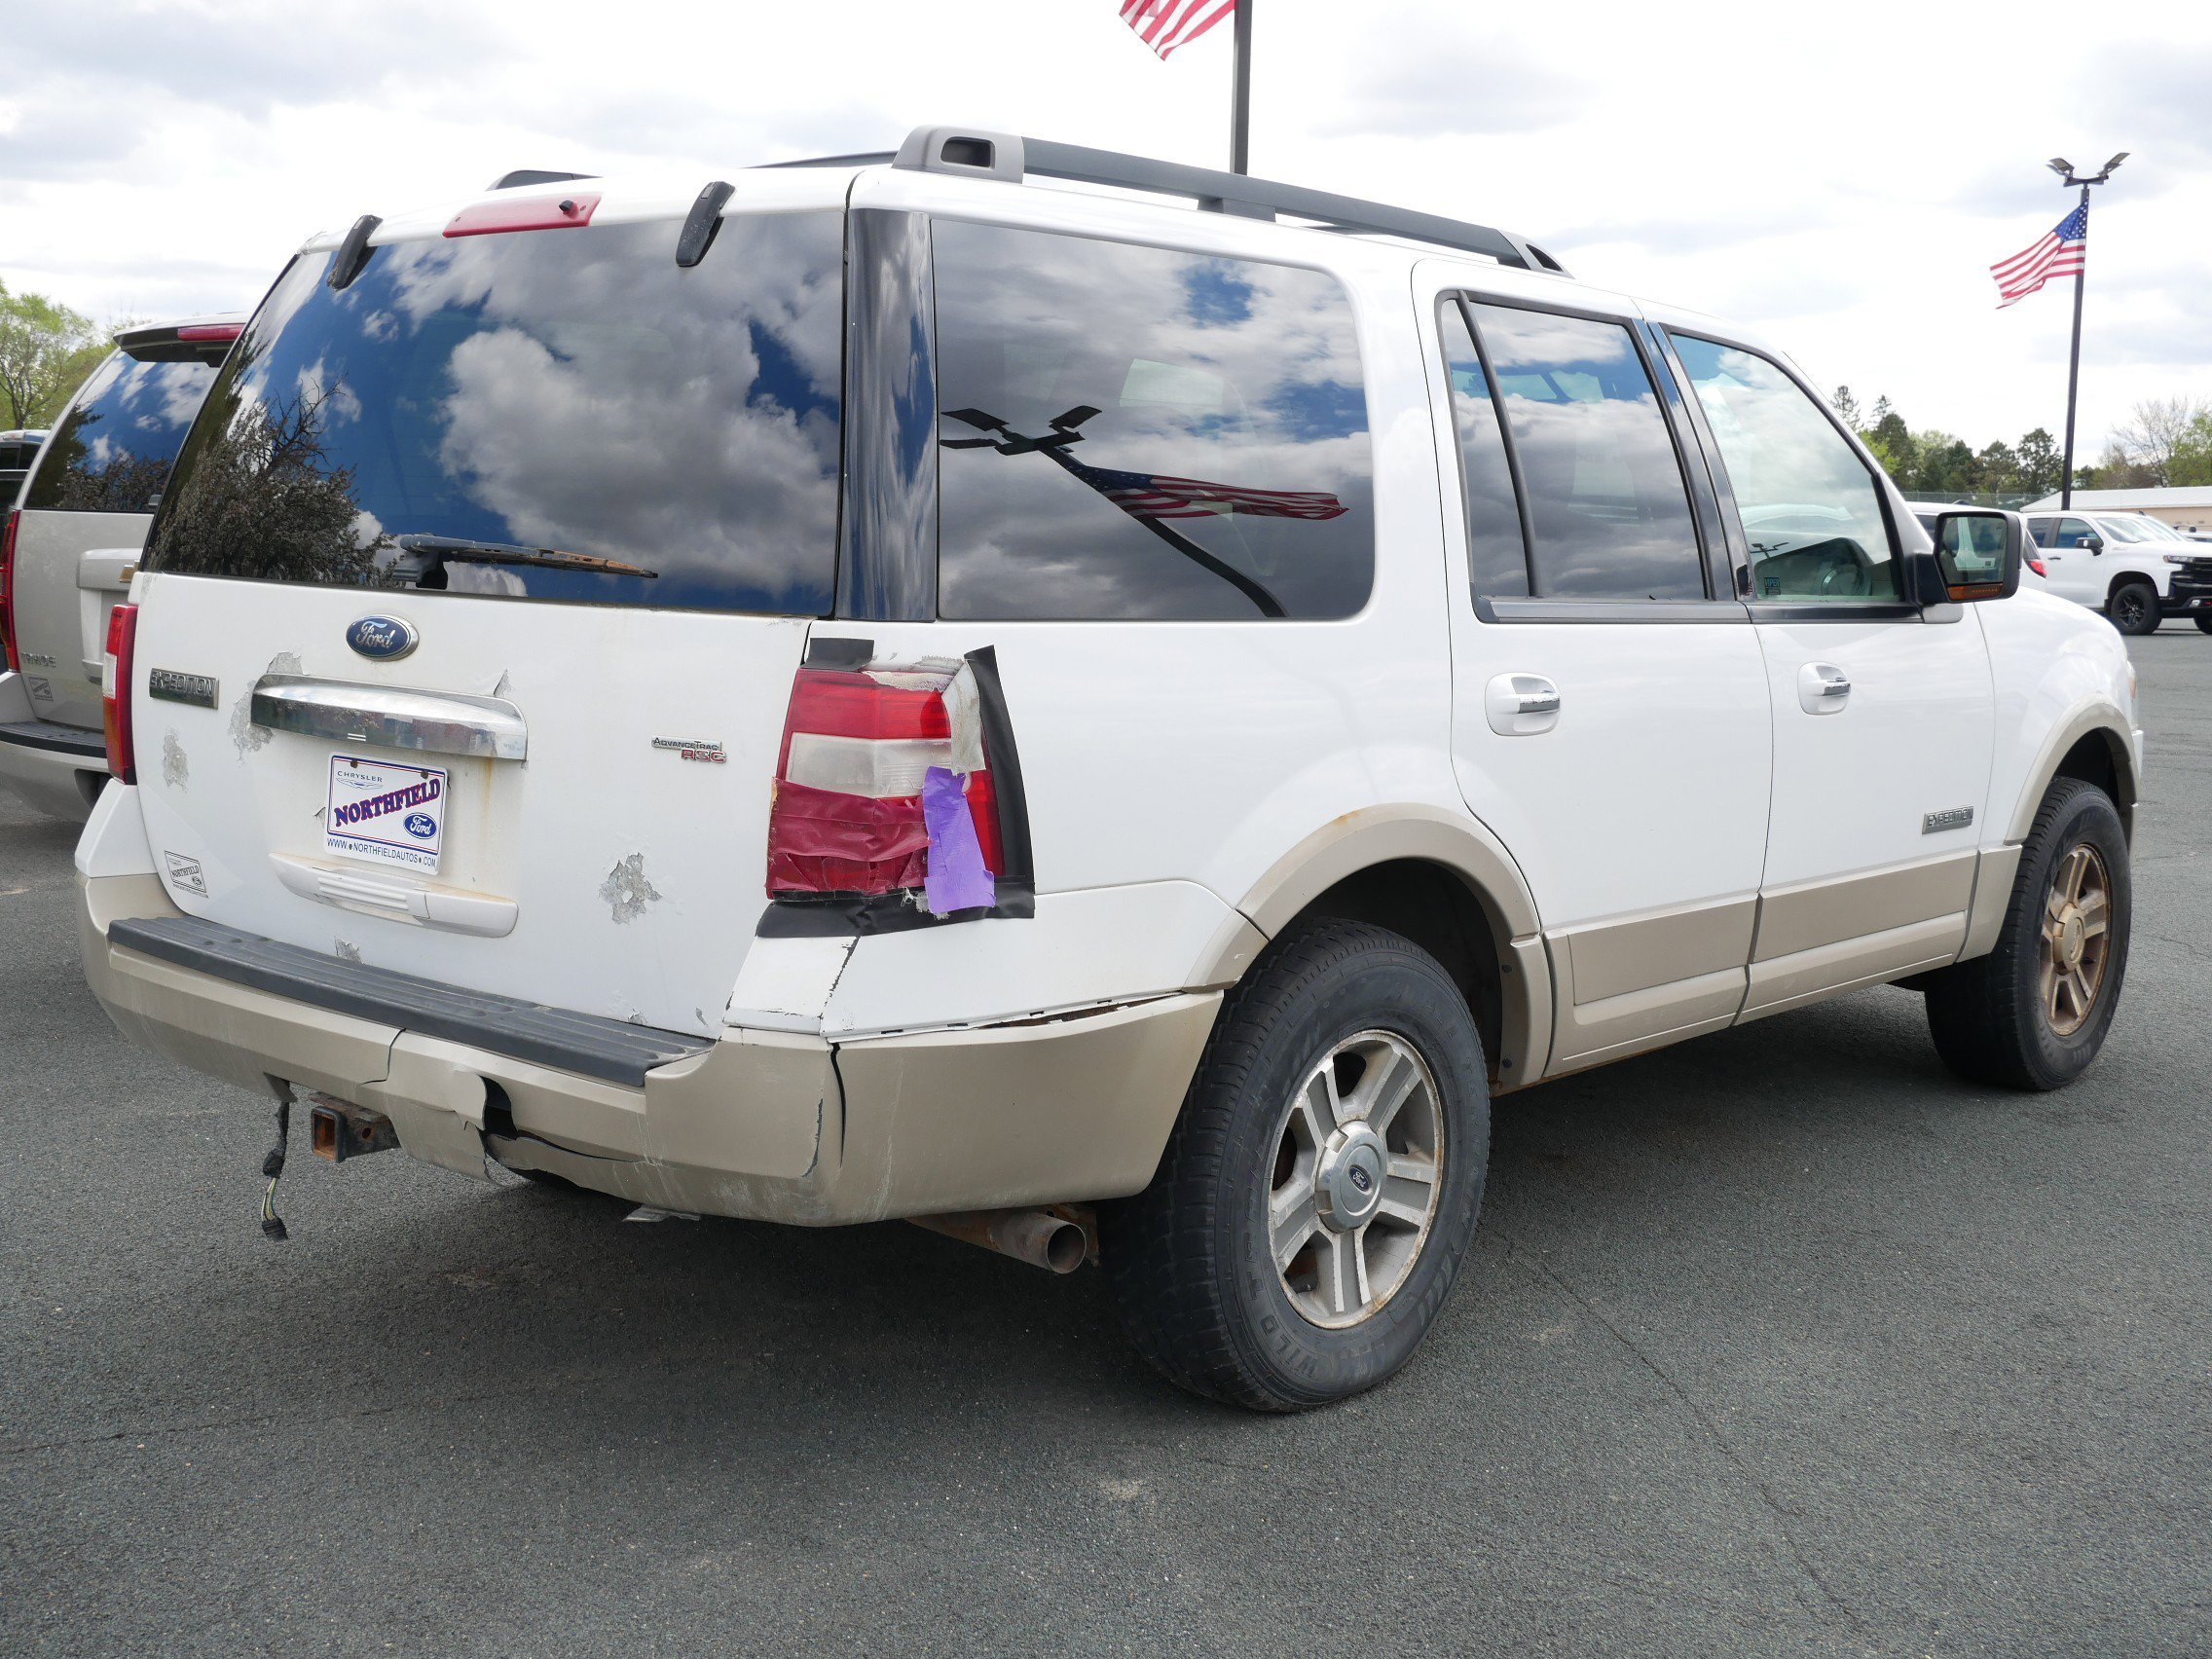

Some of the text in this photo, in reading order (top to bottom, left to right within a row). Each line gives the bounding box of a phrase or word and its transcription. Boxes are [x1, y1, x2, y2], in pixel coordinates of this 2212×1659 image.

[355, 620, 395, 648] Ford
[151, 670, 215, 697] EXPEDITION
[681, 749, 726, 763] RSC
[337, 770, 384, 783] CHRYSLER
[334, 778, 441, 828] NORTHFIELD
[409, 816, 432, 835] Ford
